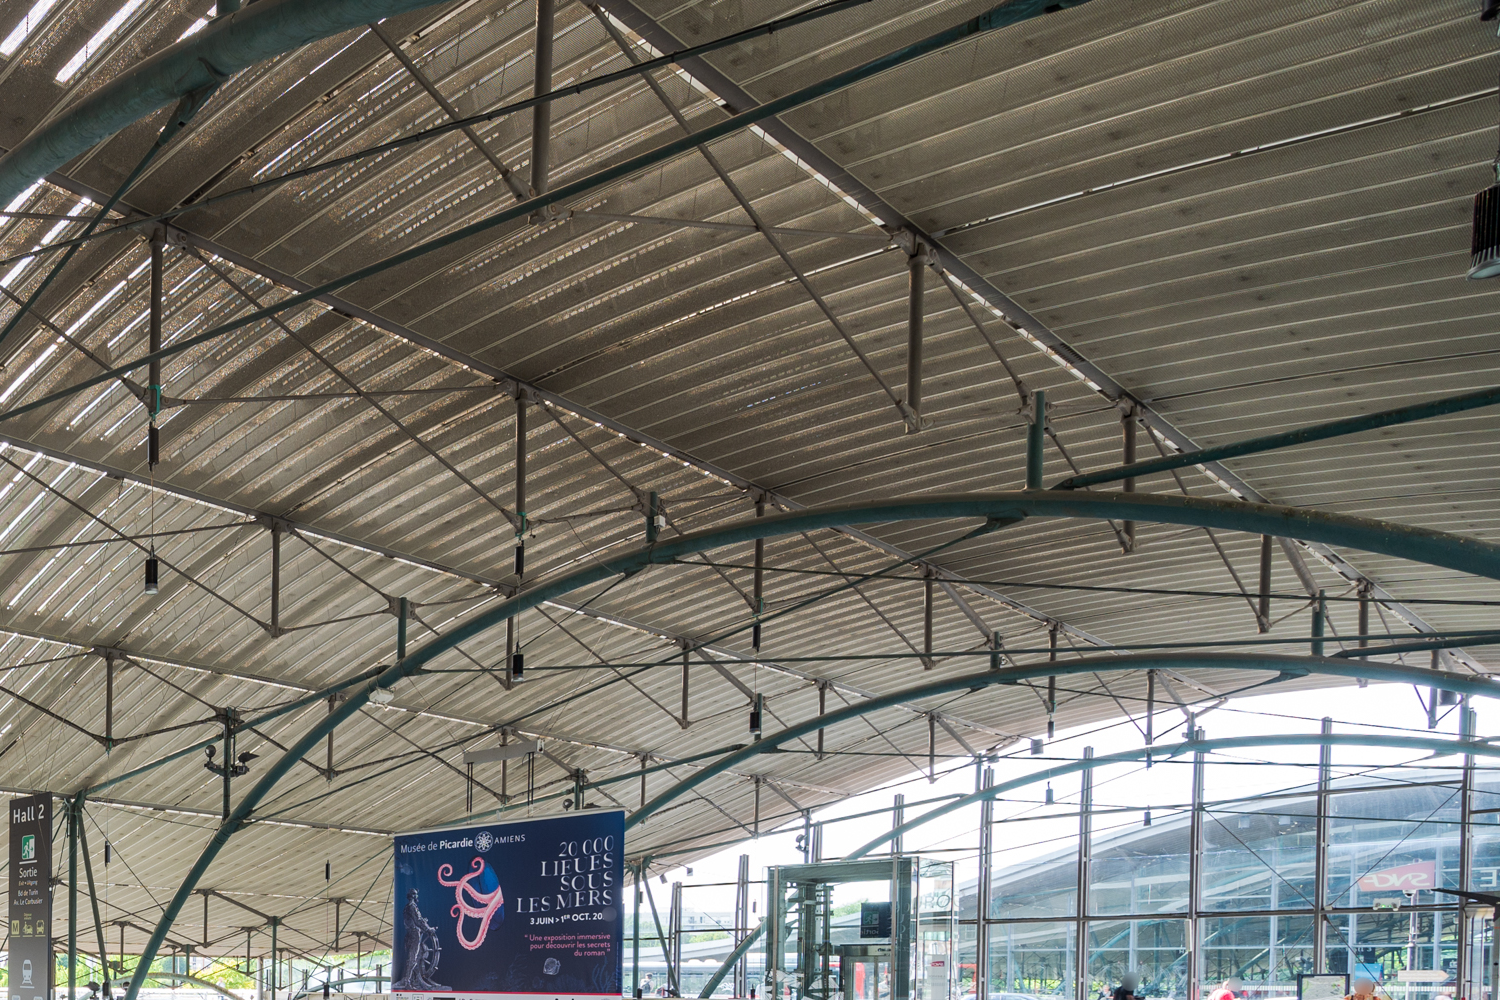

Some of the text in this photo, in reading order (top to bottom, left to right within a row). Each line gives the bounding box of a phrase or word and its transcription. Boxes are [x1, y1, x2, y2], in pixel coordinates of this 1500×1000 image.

[13, 804, 44, 824] Hall 2
[400, 838, 473, 854] Musée de Picardie
[494, 834, 526, 844] AMIENS
[558, 835, 614, 857] 20 000
[19, 866, 38, 879] Sortie
[541, 852, 613, 877] LIEUES
[560, 870, 613, 892] SOUS
[516, 889, 613, 913] LES MERS
[530, 911, 608, 925] 3 JUIN 1ER OCT. 20
[543, 934, 576, 943] exposition
[577, 932, 611, 940] immersive
[530, 943, 544, 951] pour
[546, 941, 576, 949] découvrir
